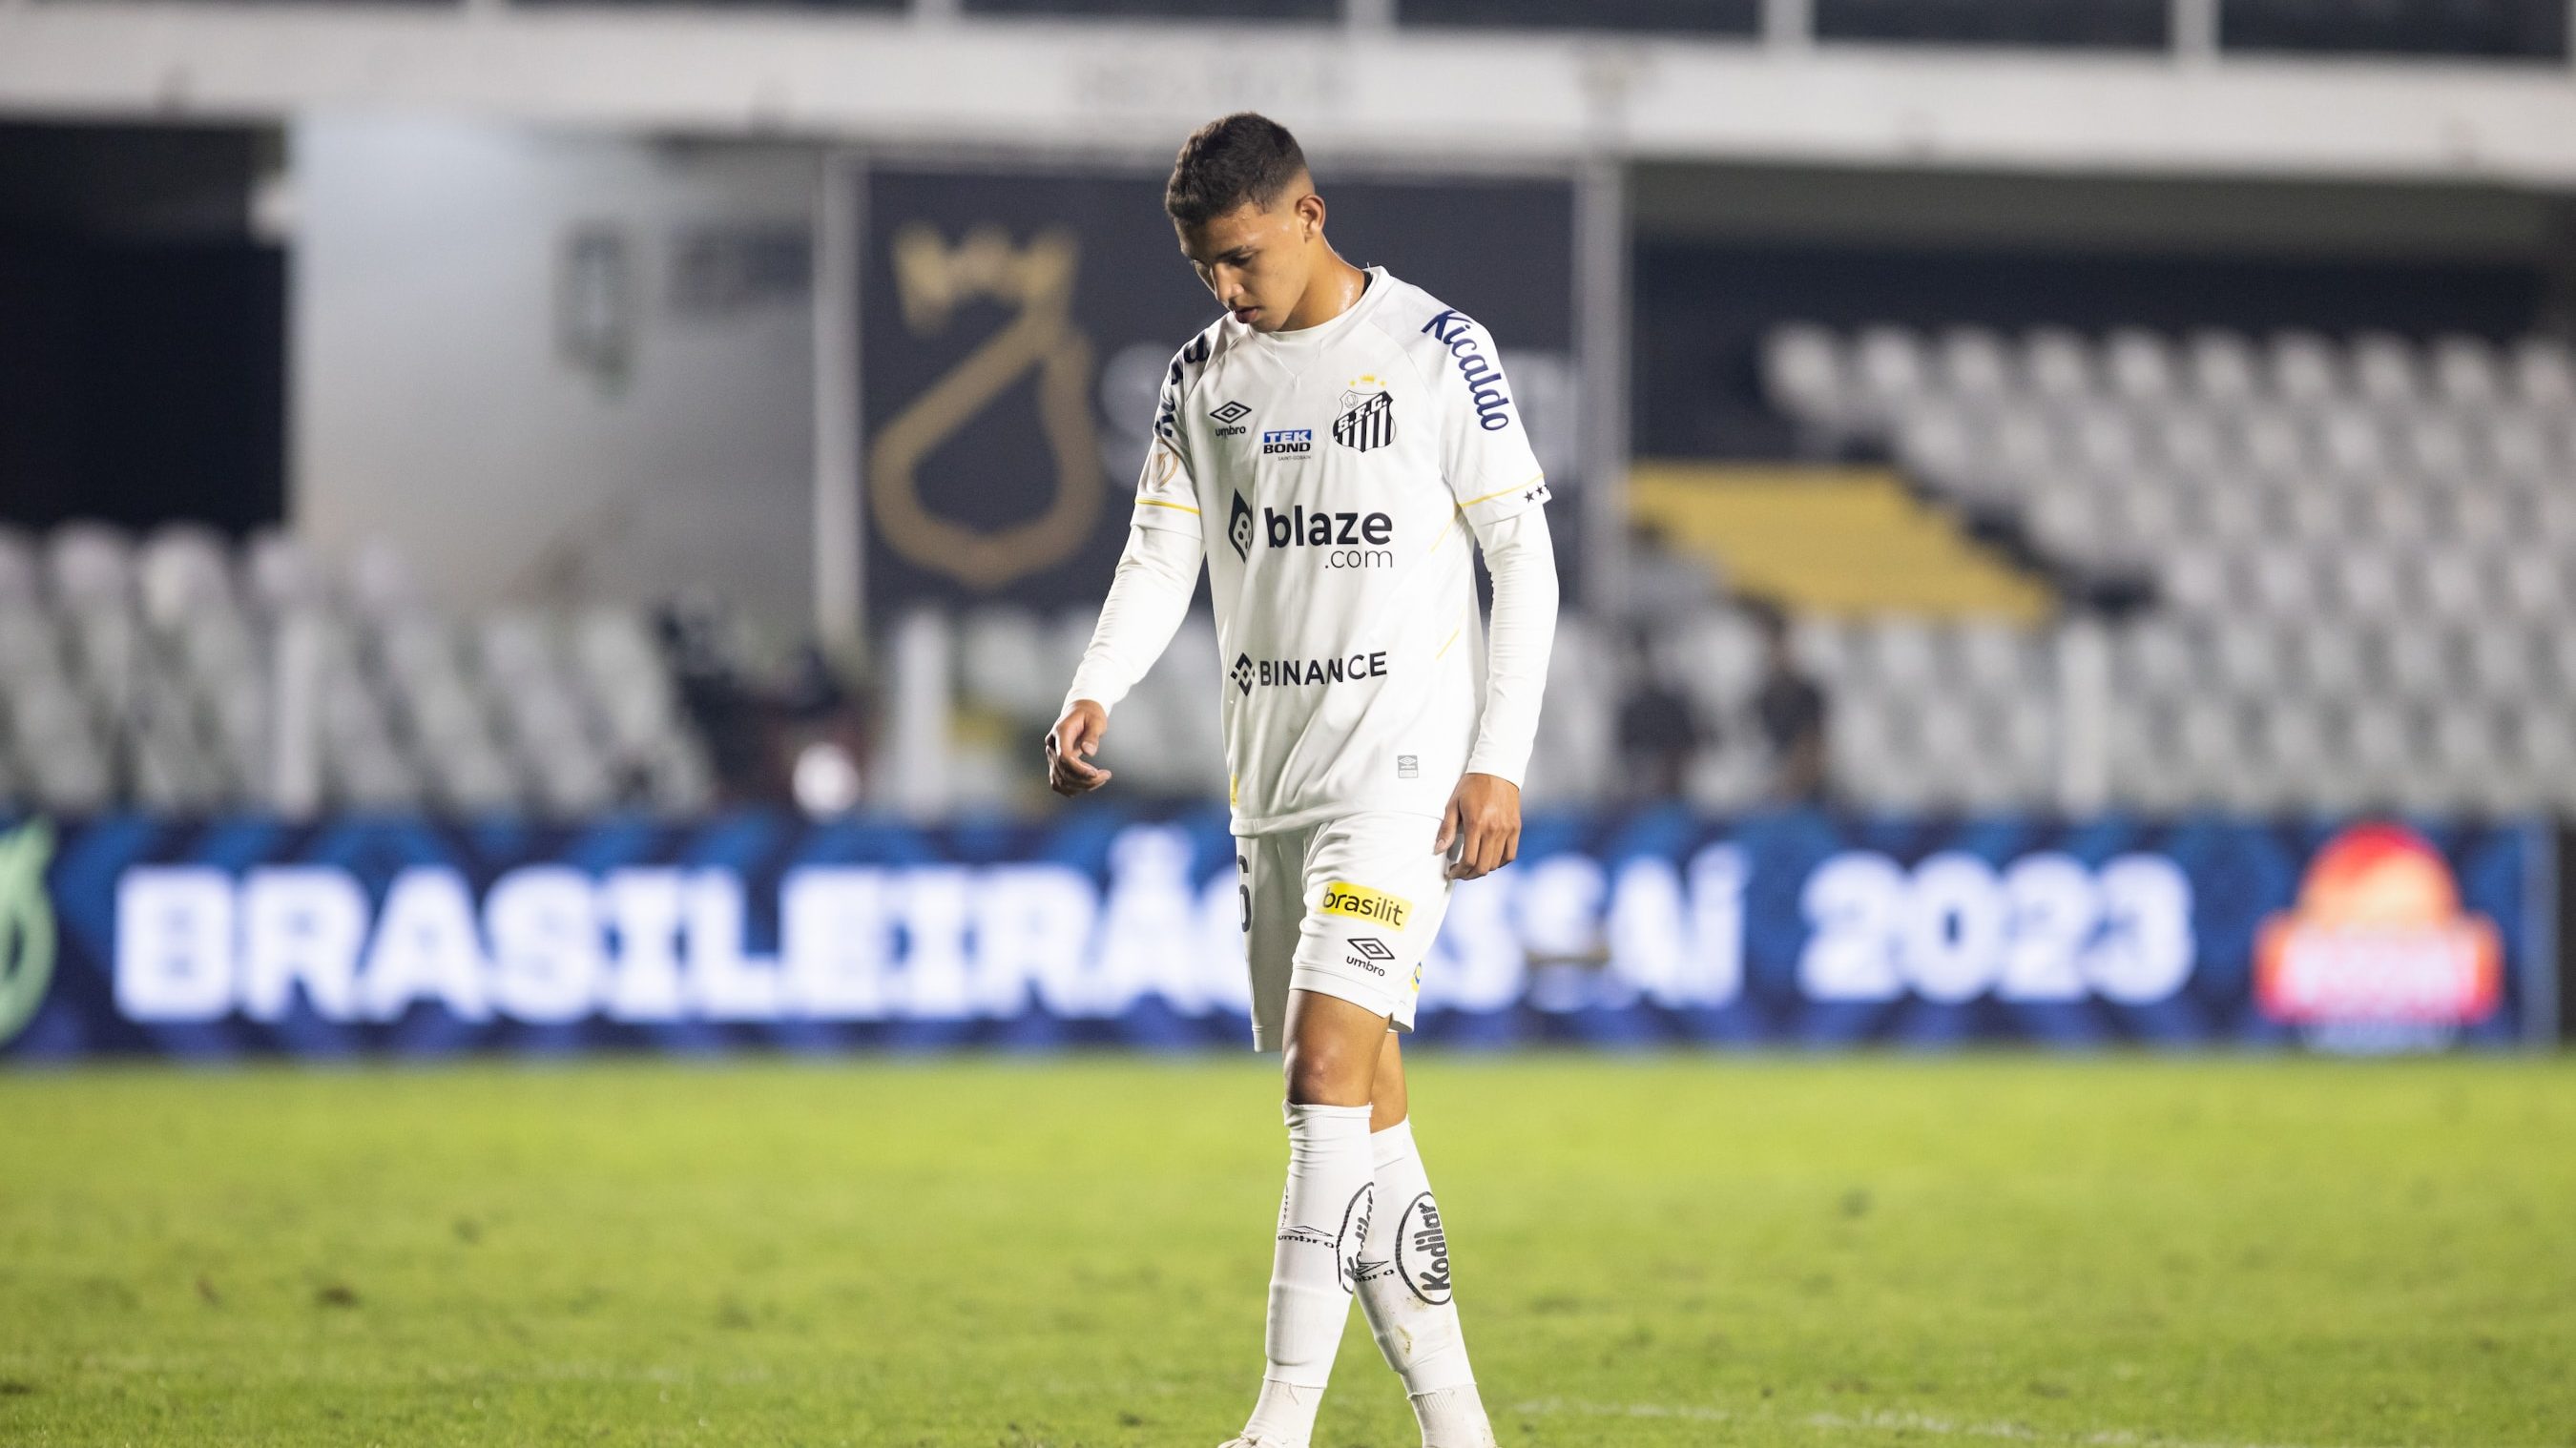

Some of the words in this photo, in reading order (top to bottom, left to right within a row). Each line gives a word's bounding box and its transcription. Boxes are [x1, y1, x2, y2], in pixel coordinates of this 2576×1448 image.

[1421, 309, 1509, 431] Kicaldo
[1215, 425, 1246, 437] umbro
[1266, 431, 1308, 443] TEK
[1263, 443, 1310, 454] BOND
[1264, 505, 1393, 548] blaze
[1324, 550, 1393, 569] .com
[1259, 651, 1387, 687] BINANCE
[1322, 886, 1403, 926] brasilit
[1797, 850, 2195, 1004] 2023
[1346, 956, 1385, 977] umbro
[1278, 1235, 1334, 1248] umbro
[1414, 1202, 1450, 1291] Kodilar
